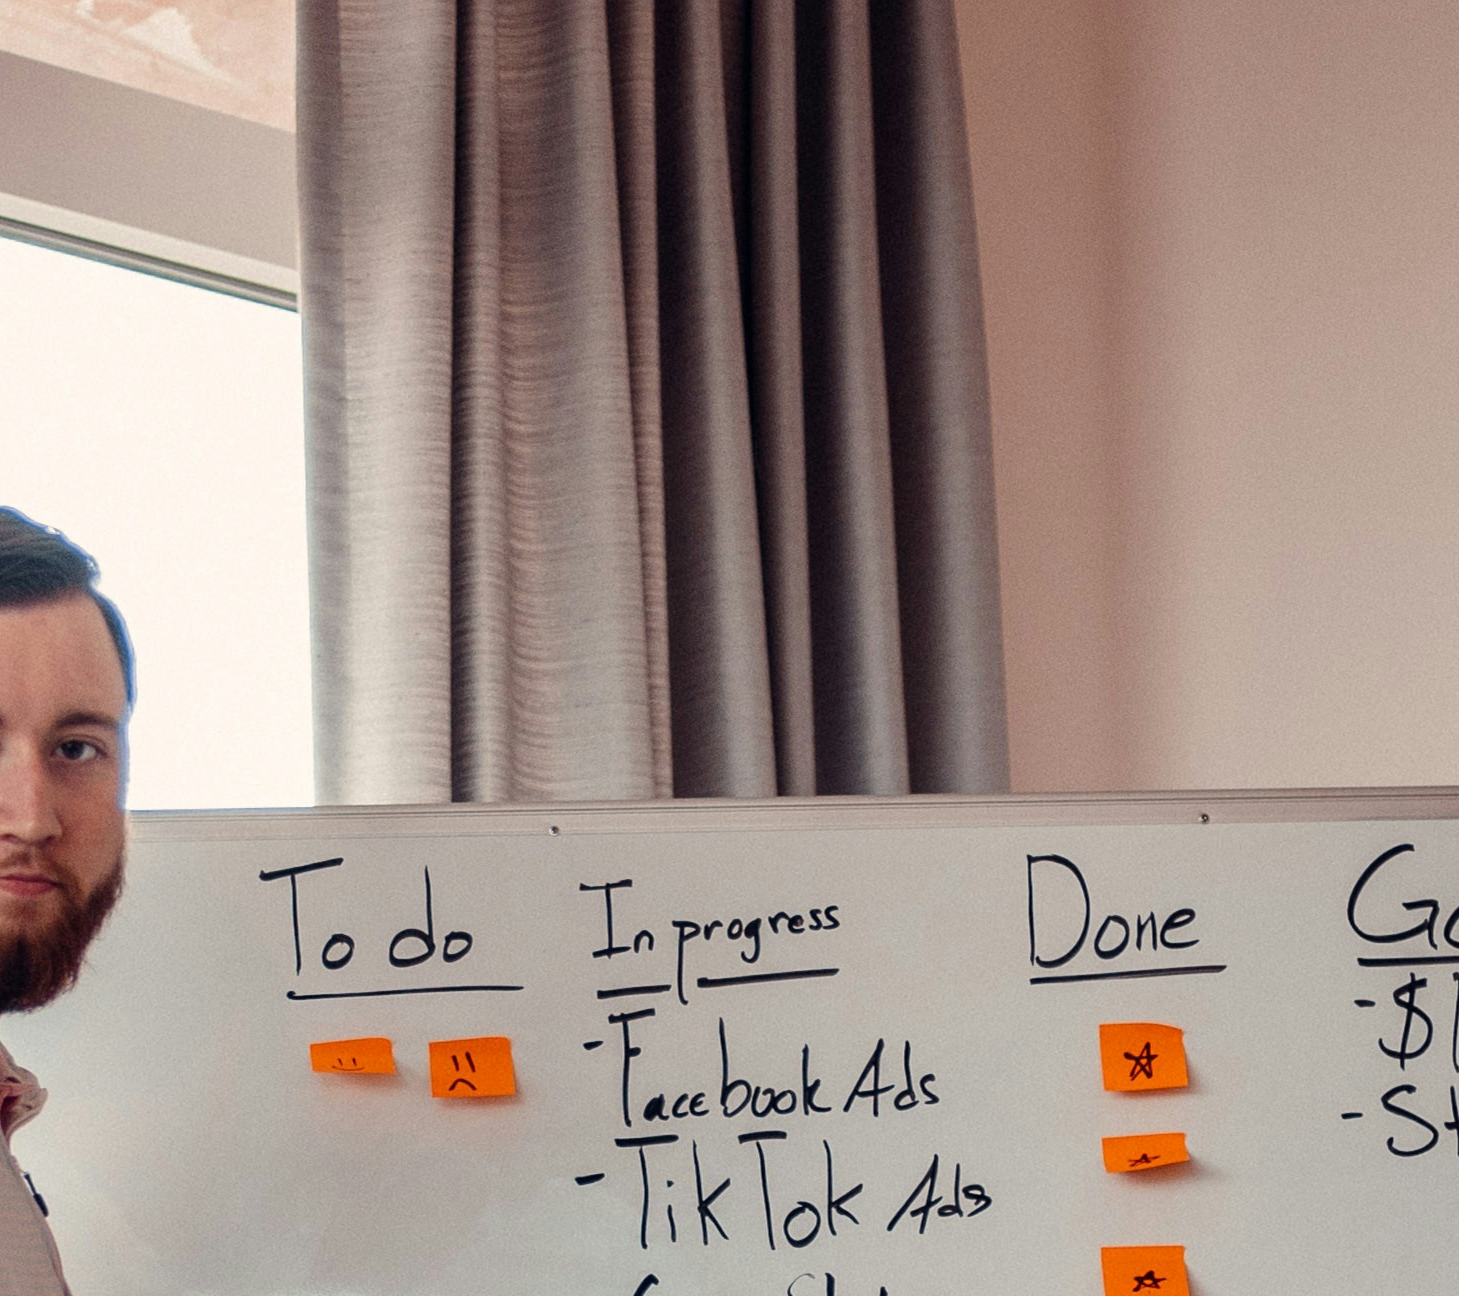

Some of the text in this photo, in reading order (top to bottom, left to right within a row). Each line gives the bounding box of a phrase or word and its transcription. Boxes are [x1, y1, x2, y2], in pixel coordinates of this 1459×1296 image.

[258, 856, 475, 974] To do
[578, 878, 842, 1007] In progress
[1025, 853, 1200, 970] Done
[841, 1037, 941, 1118] Ads
[885, 1152, 994, 1236] Ads
